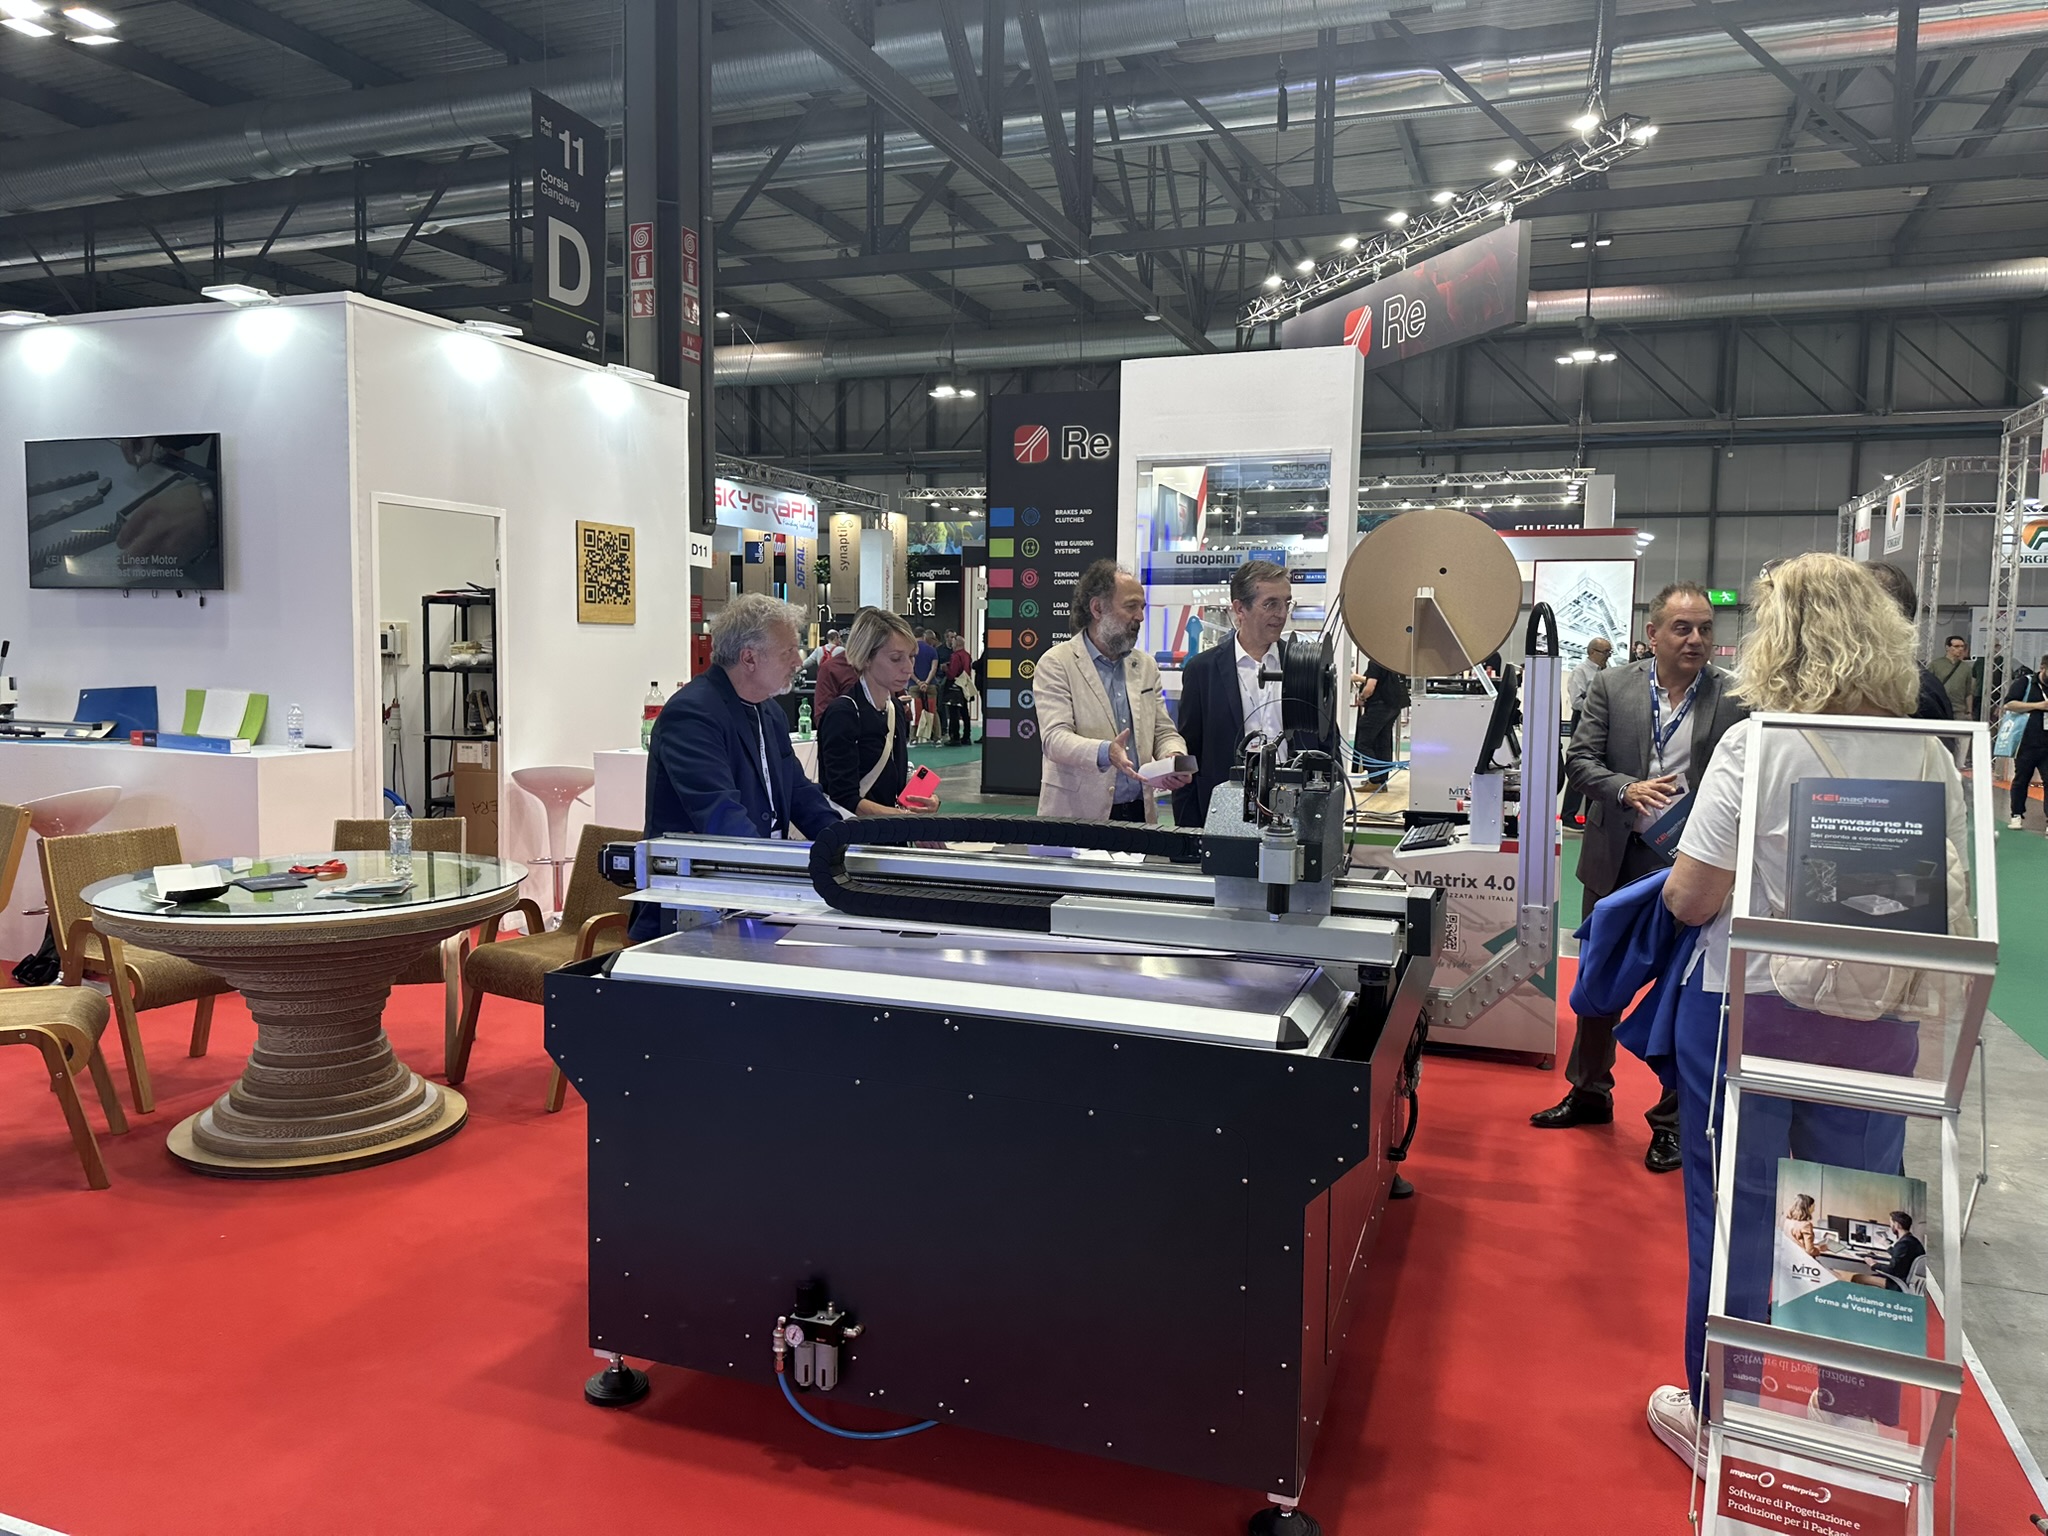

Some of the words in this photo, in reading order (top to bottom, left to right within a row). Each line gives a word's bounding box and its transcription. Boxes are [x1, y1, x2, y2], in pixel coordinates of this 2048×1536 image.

[559, 129, 584, 177] 11
[540, 168, 569, 192] Corsia
[540, 182, 580, 213] Gangway
[548, 215, 591, 307] D
[1382, 293, 1427, 349] Re
[1061, 425, 1111, 460] Re
[122, 555, 149, 565] Linear
[151, 555, 178, 565] Motor
[691, 543, 708, 558] D11
[133, 568, 184, 577] movements
[1811, 816, 1902, 828] L'innovazione
[1904, 821, 1923, 829] ha
[1839, 825, 1880, 833] nuova
[1883, 826, 1923, 835] forma
[1859, 836, 1908, 844] conoscerla?
[1414, 870, 1478, 889] Matrix
[1484, 874, 1515, 891] 4.0
[1814, 1295, 1839, 1307] forma
[1851, 1303, 1876, 1315] Vostri
[1877, 1309, 1913, 1322] progetti
[1846, 1293, 1884, 1308] Aiutiamo
[1893, 1303, 1913, 1313] dare
[1729, 1468, 1758, 1481] impact
[1782, 1482, 1820, 1498] enterprise
[1727, 1499, 1783, 1522] Produzione
[1784, 1516, 1801, 1530] per
[1802, 1519, 1809, 1530] il
[1728, 1485, 1772, 1505] Software
[1773, 1498, 1783, 1509] di
[1785, 1500, 1853, 1528] Progettazione
[1854, 1522, 1861, 1530] e
